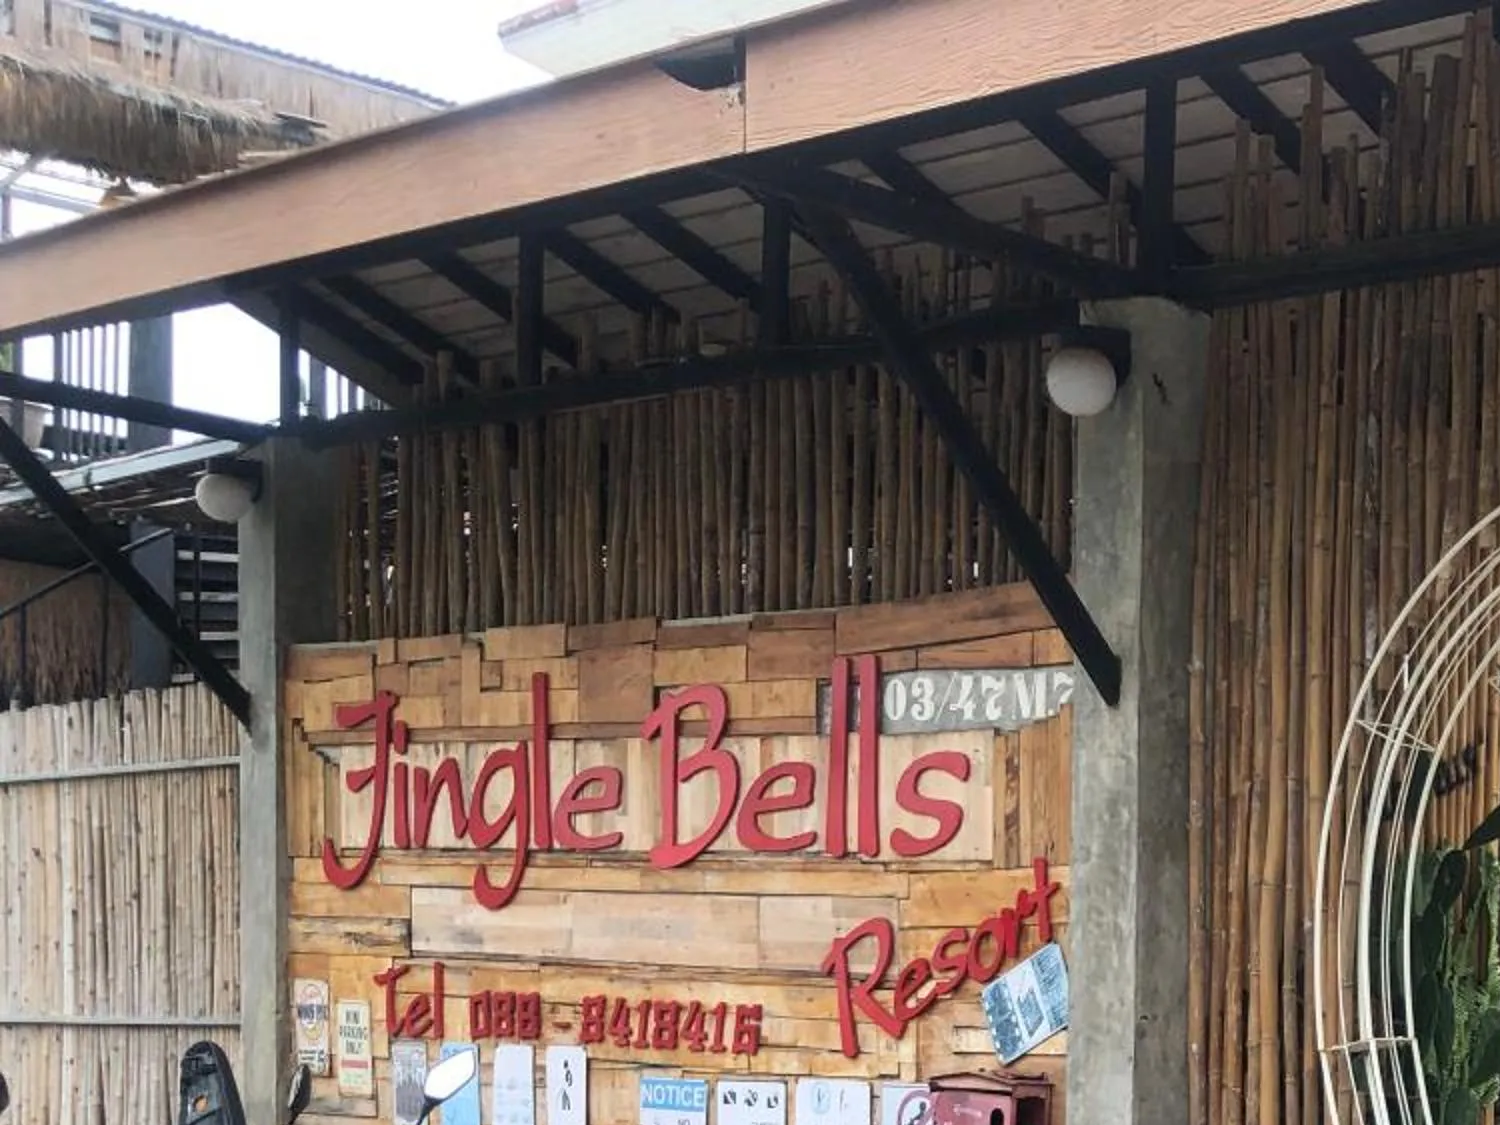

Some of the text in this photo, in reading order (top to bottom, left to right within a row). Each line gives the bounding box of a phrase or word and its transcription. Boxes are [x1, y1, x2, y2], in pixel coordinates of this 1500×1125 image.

[323, 654, 973, 909] Jingle Bells
[373, 960, 446, 1040] Tel
[822, 857, 1062, 1058] Resort
[641, 1082, 705, 1106] NOTICE
